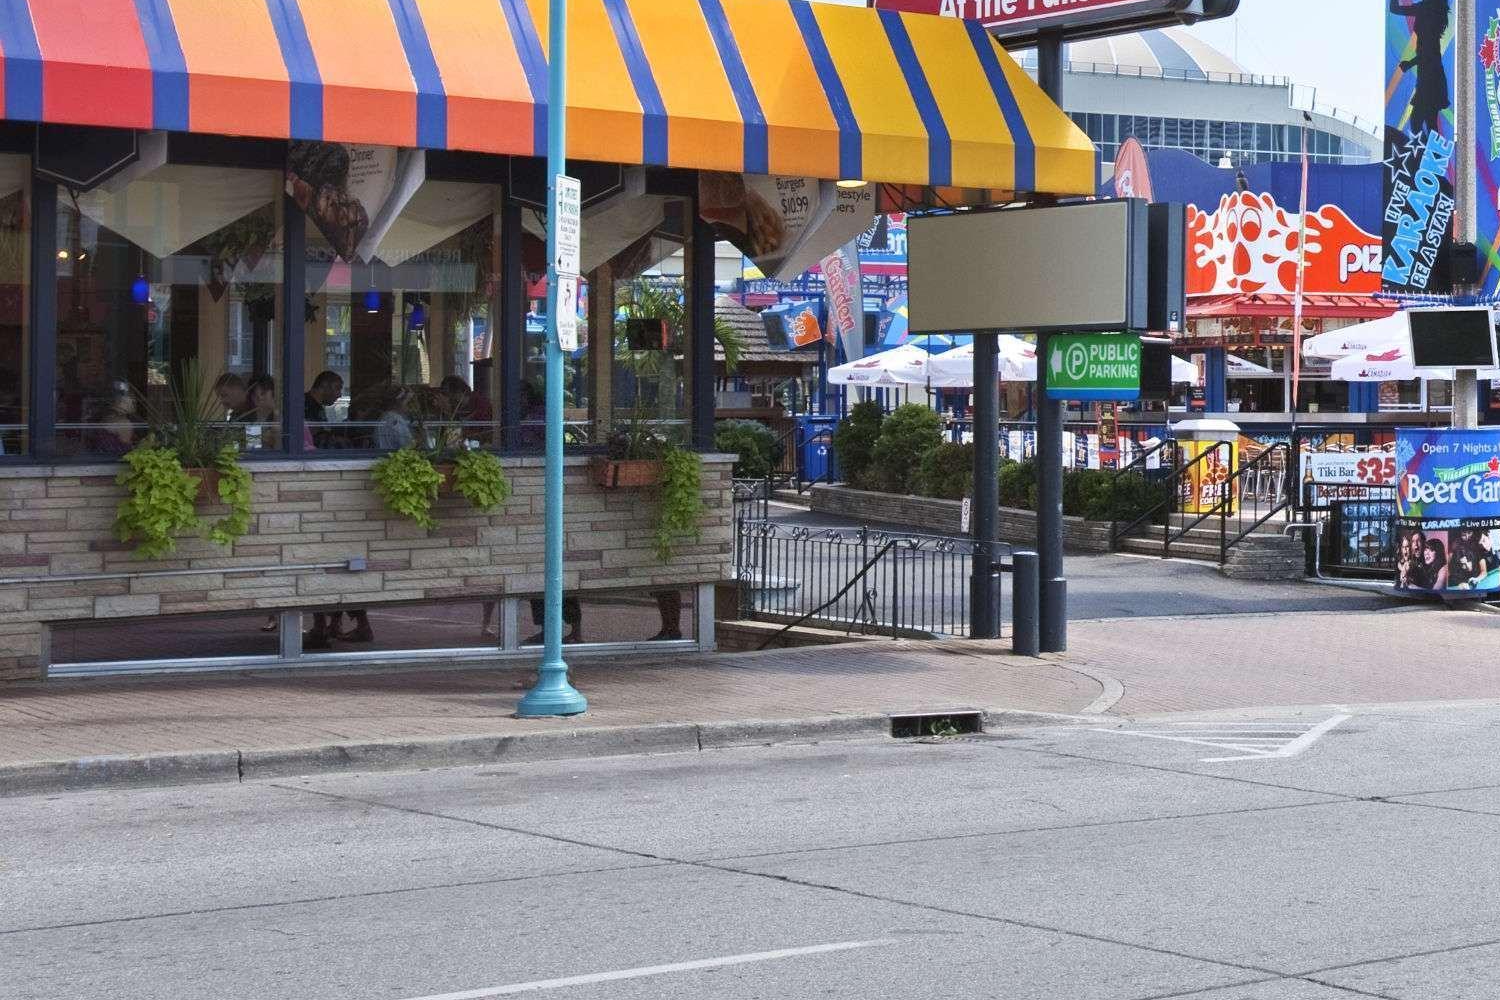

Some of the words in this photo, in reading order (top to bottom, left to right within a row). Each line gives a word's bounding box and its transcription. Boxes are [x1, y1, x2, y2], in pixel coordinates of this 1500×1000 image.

[776, 178, 805, 192] Burgers
[782, 196, 808, 214] $10.99
[1382, 130, 1454, 285] KARAOKE
[1385, 180, 1410, 223] LIVE
[1426, 194, 1454, 247] STAR!
[1420, 246, 1437, 264] A
[1410, 262, 1431, 289] BE
[1090, 344, 1137, 361] PUBLIC
[1089, 364, 1137, 378] PARKING
[1422, 443, 1448, 454] Open
[1453, 443, 1459, 453] 7
[1463, 443, 1491, 455] Nights
[1318, 466, 1337, 477] Tiki
[1339, 466, 1355, 477] Bar
[1407, 474, 1461, 504] Beer
[1422, 518, 1460, 529] KARAOKE
